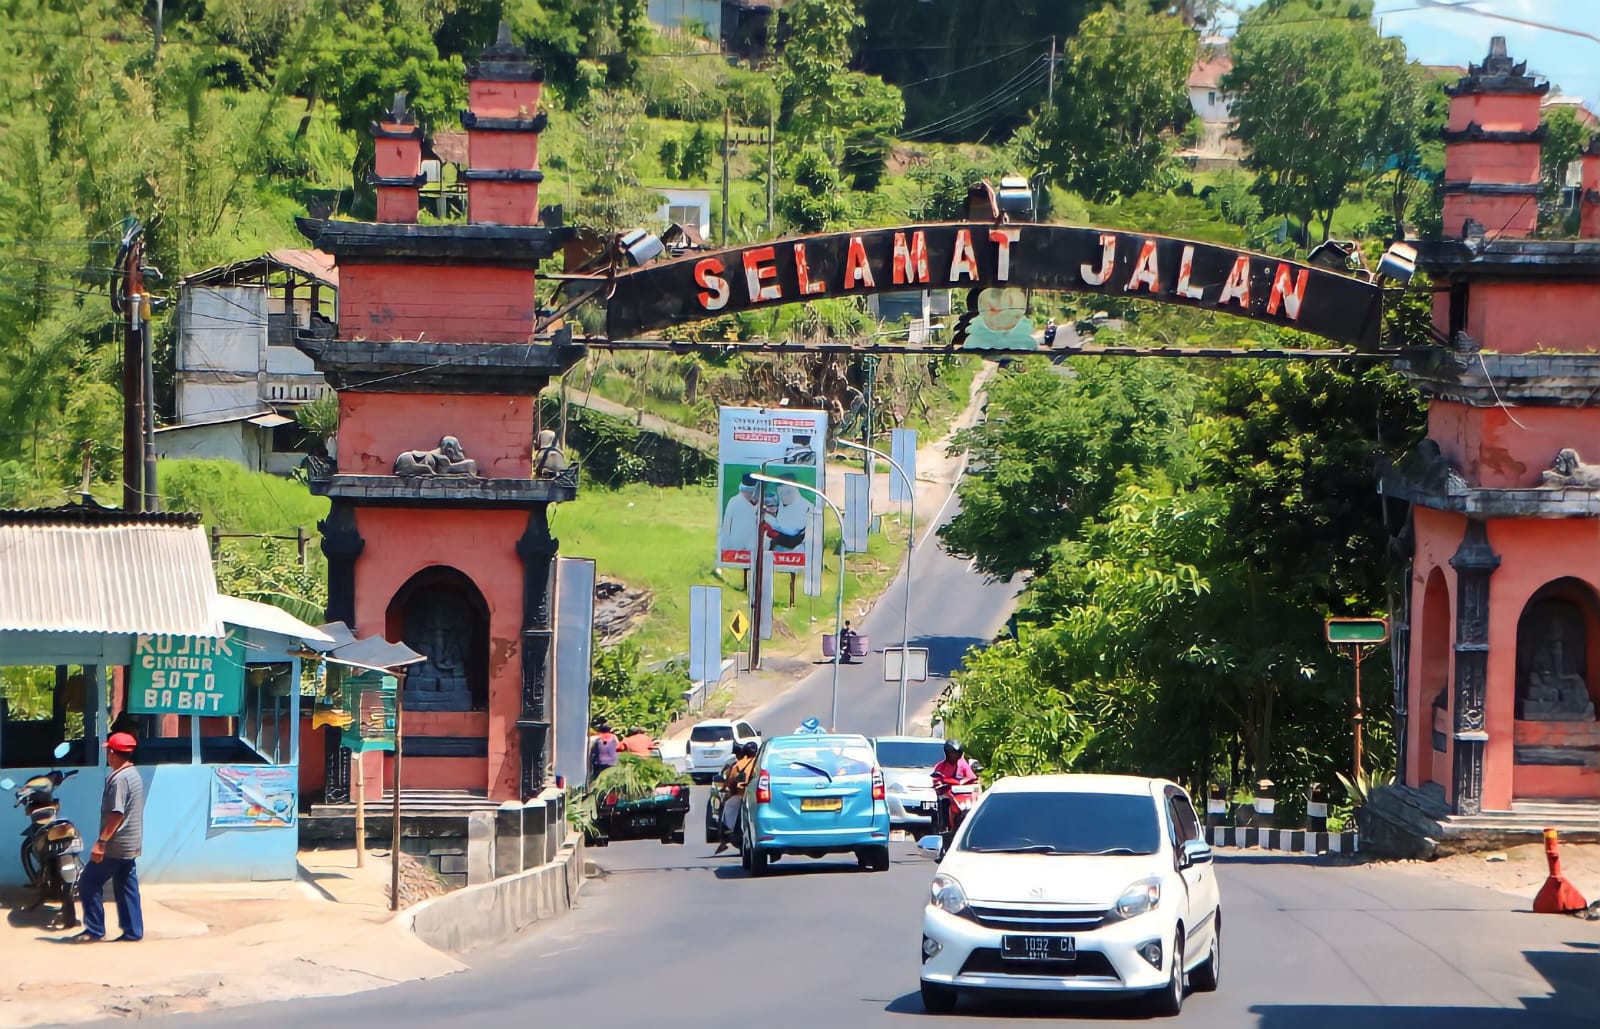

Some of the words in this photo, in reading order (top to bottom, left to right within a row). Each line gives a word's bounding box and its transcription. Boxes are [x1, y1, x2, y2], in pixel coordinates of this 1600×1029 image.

[694, 229, 1022, 311] SELAMAT
[1080, 234, 1310, 321] JALAN
[151, 670, 215, 691] SOTO
[144, 689, 224, 711] BABAT
[1004, 935, 1012, 951] L
